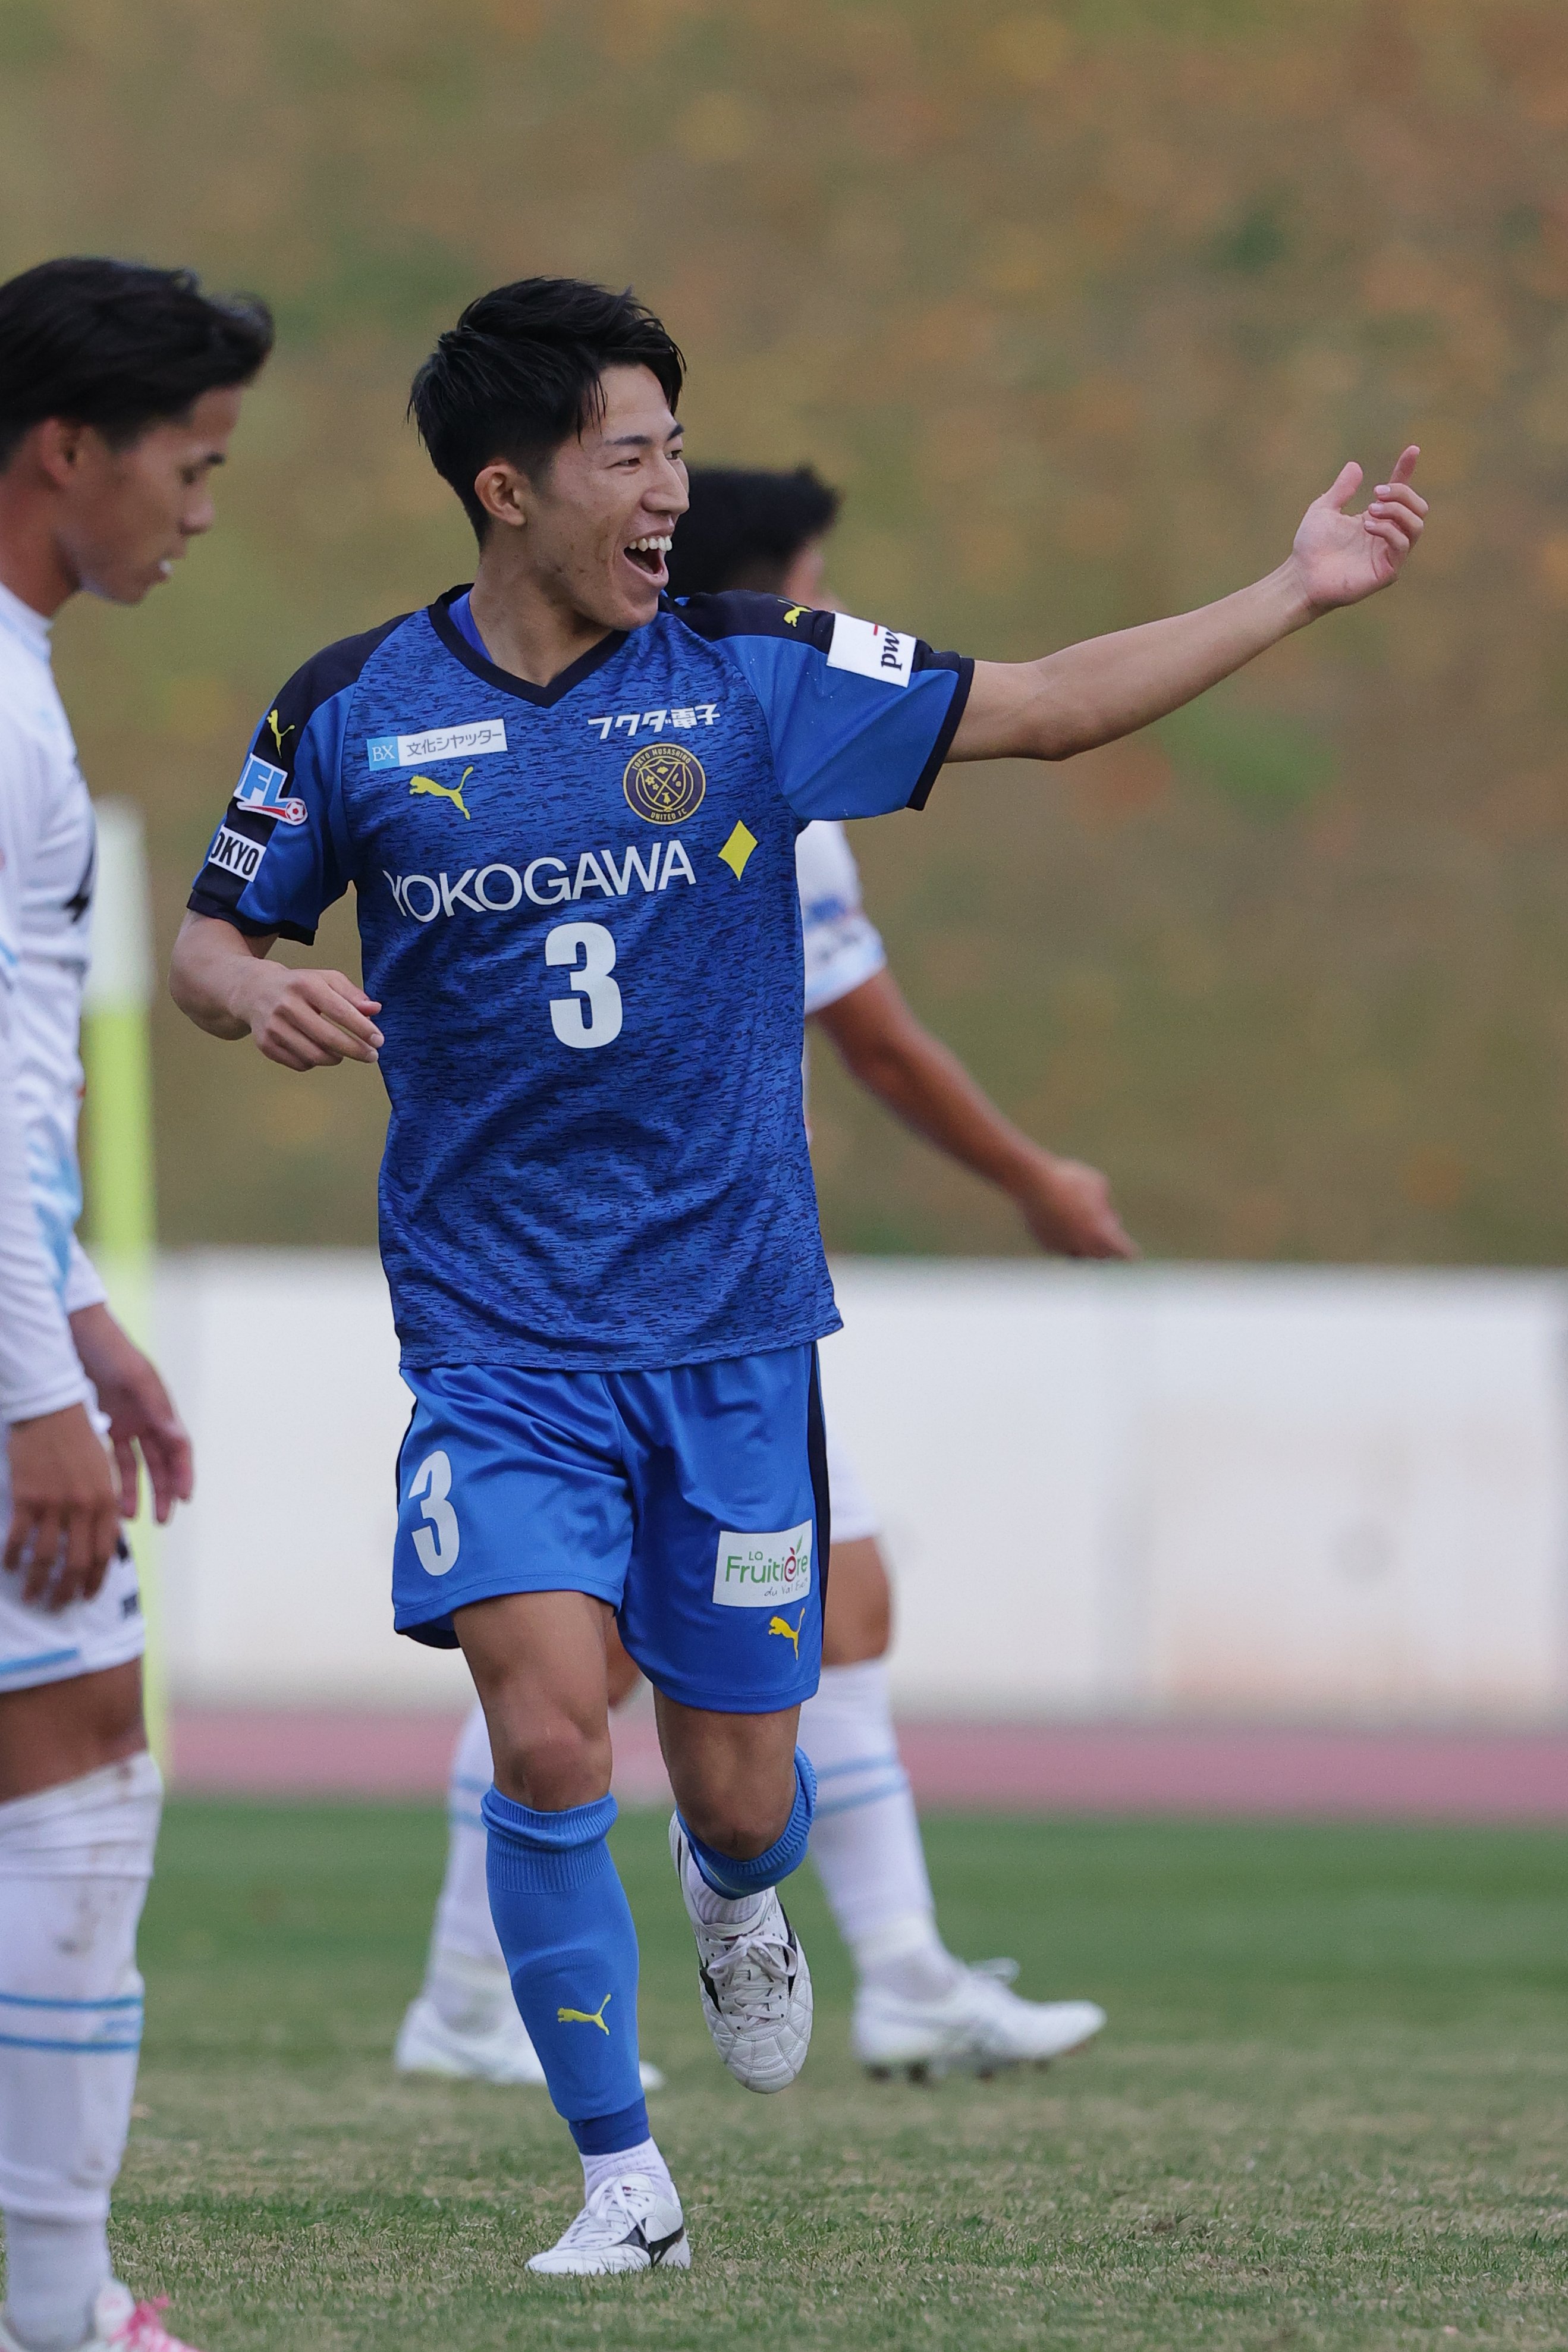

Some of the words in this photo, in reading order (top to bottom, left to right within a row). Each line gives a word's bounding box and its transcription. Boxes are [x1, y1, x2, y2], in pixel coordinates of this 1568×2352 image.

[587, 704, 720, 740] フクダ電子
[372, 745, 395, 762] BX
[406, 729, 502, 757] 文化シャッター
[631, 752, 651, 770] TOKYO
[238, 759, 287, 808] FL
[651, 811, 677, 821] UNITED
[678, 808, 687, 818] FC
[383, 840, 697, 922] YOKOGAWA
[545, 922, 623, 1049] 3
[408, 1450, 460, 1576] 3
